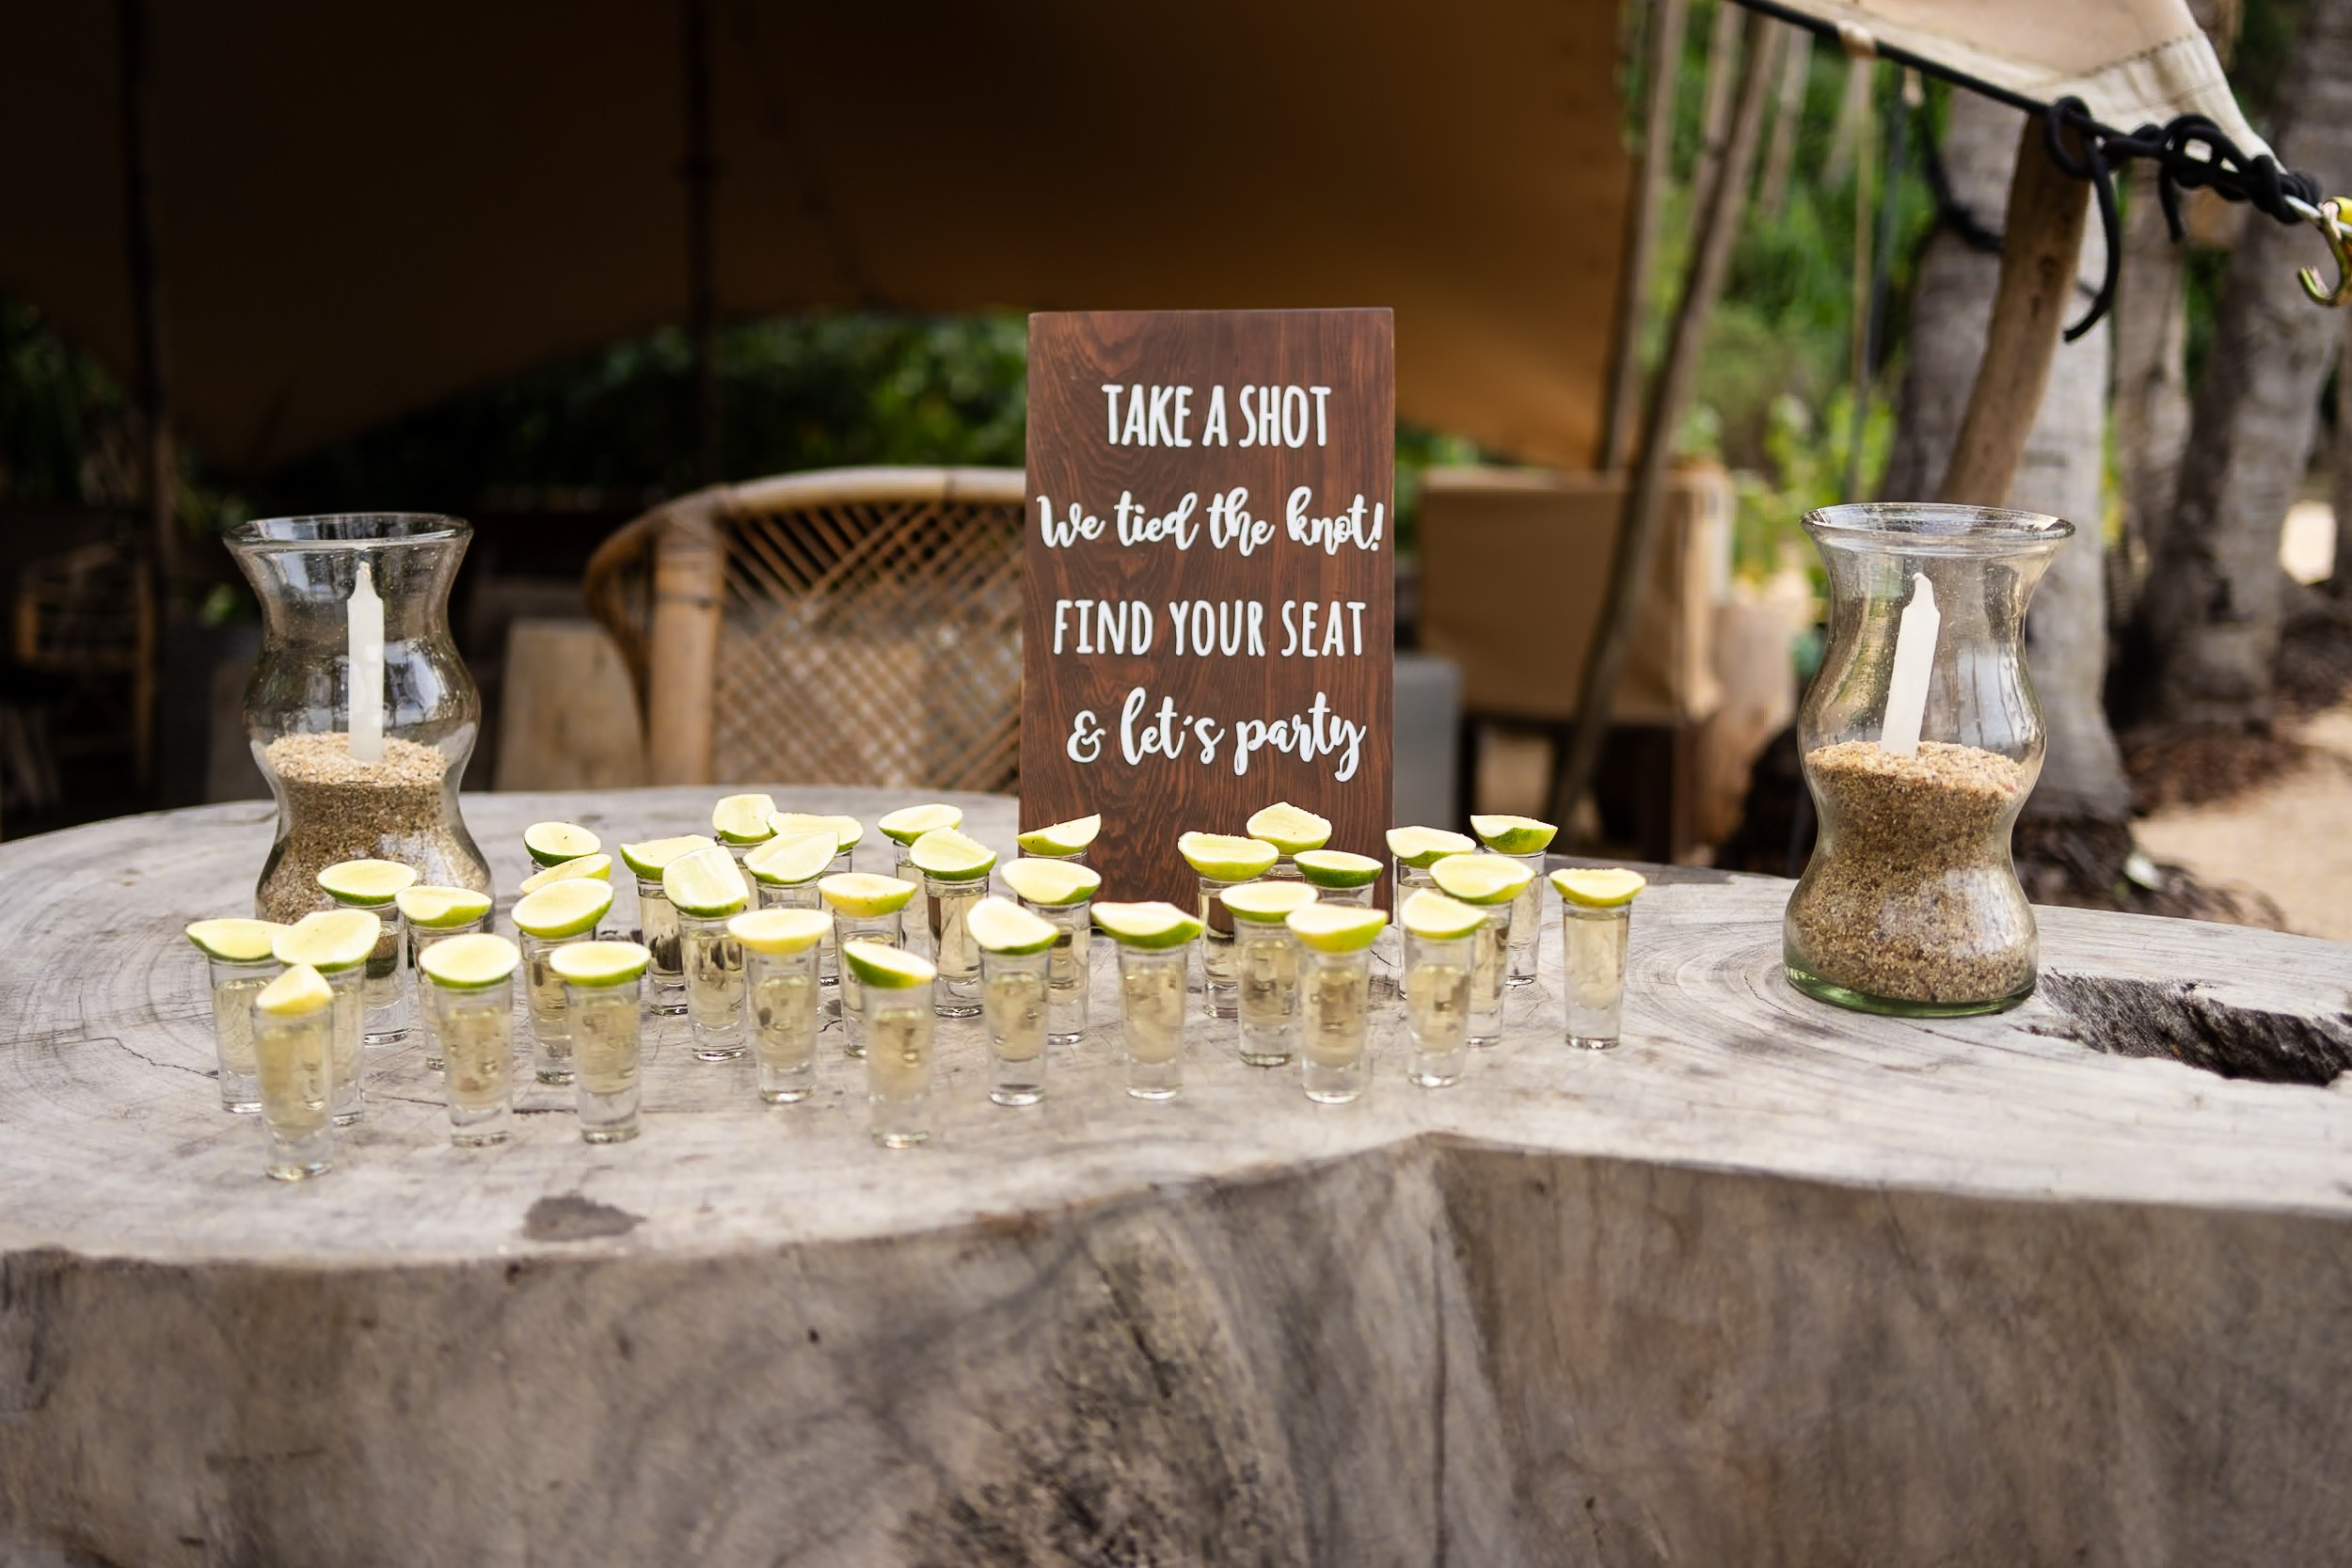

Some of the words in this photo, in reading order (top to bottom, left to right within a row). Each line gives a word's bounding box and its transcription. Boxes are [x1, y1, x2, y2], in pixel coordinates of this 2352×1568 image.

[1101, 384, 1194, 448] TAKE
[1201, 385, 1229, 448] A
[1238, 384, 1332, 449] SHOT
[1036, 495, 1106, 549] We
[1113, 490, 1200, 551] tied
[1205, 486, 1277, 557] the
[1285, 485, 1386, 556] knot!
[1053, 599, 1153, 656] FIND
[1168, 599, 1266, 657] YOUR
[1280, 599, 1367, 657] SEAT
[1066, 709, 1106, 764] &
[1120, 687, 1226, 767] let's
[1233, 690, 1367, 783] party
